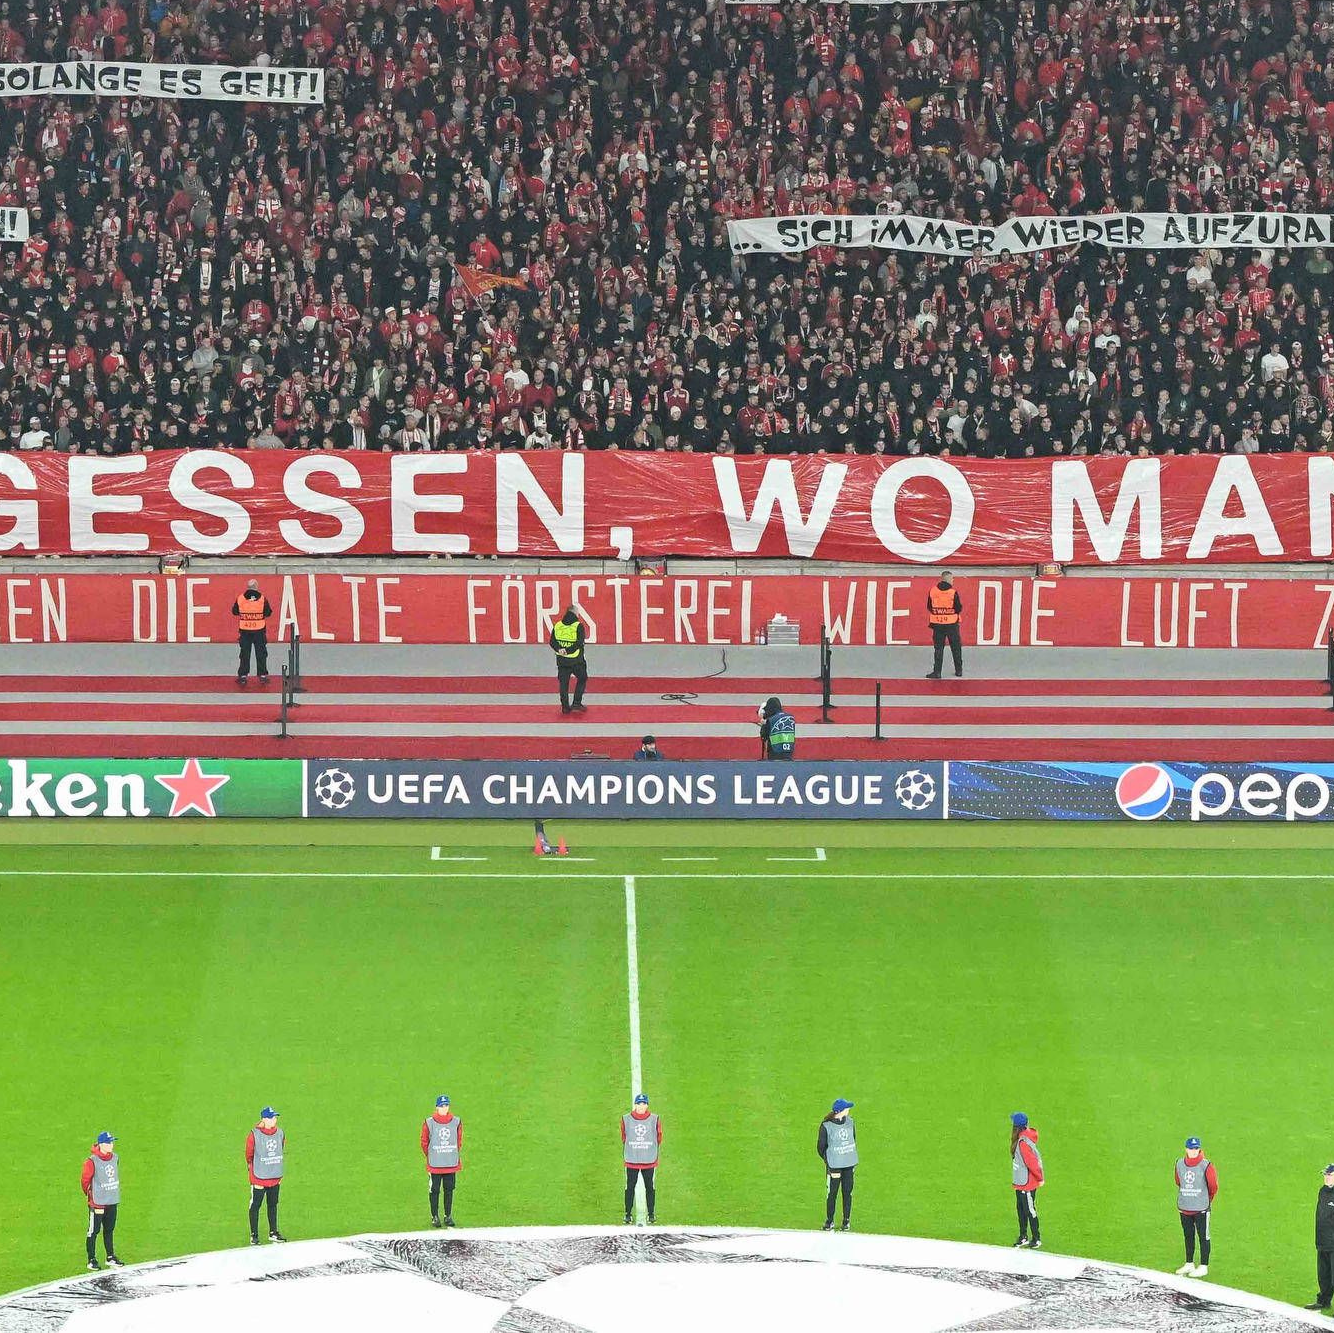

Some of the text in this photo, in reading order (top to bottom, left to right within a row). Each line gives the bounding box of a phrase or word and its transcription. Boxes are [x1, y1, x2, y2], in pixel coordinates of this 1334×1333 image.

[160, 69, 203, 96] ES
[220, 70, 319, 101] GEHT!
[712, 455, 975, 562] WO
[131, 576, 210, 642] DIE
[278, 575, 403, 643] ALTE
[467, 575, 753, 645] FÖRSTEREI
[823, 580, 911, 646] WIE
[977, 580, 1056, 646] DIE
[1120, 581, 1249, 648] LUFT
[367, 774, 883, 805] UEFA CHAMPIONS LEAGUE
